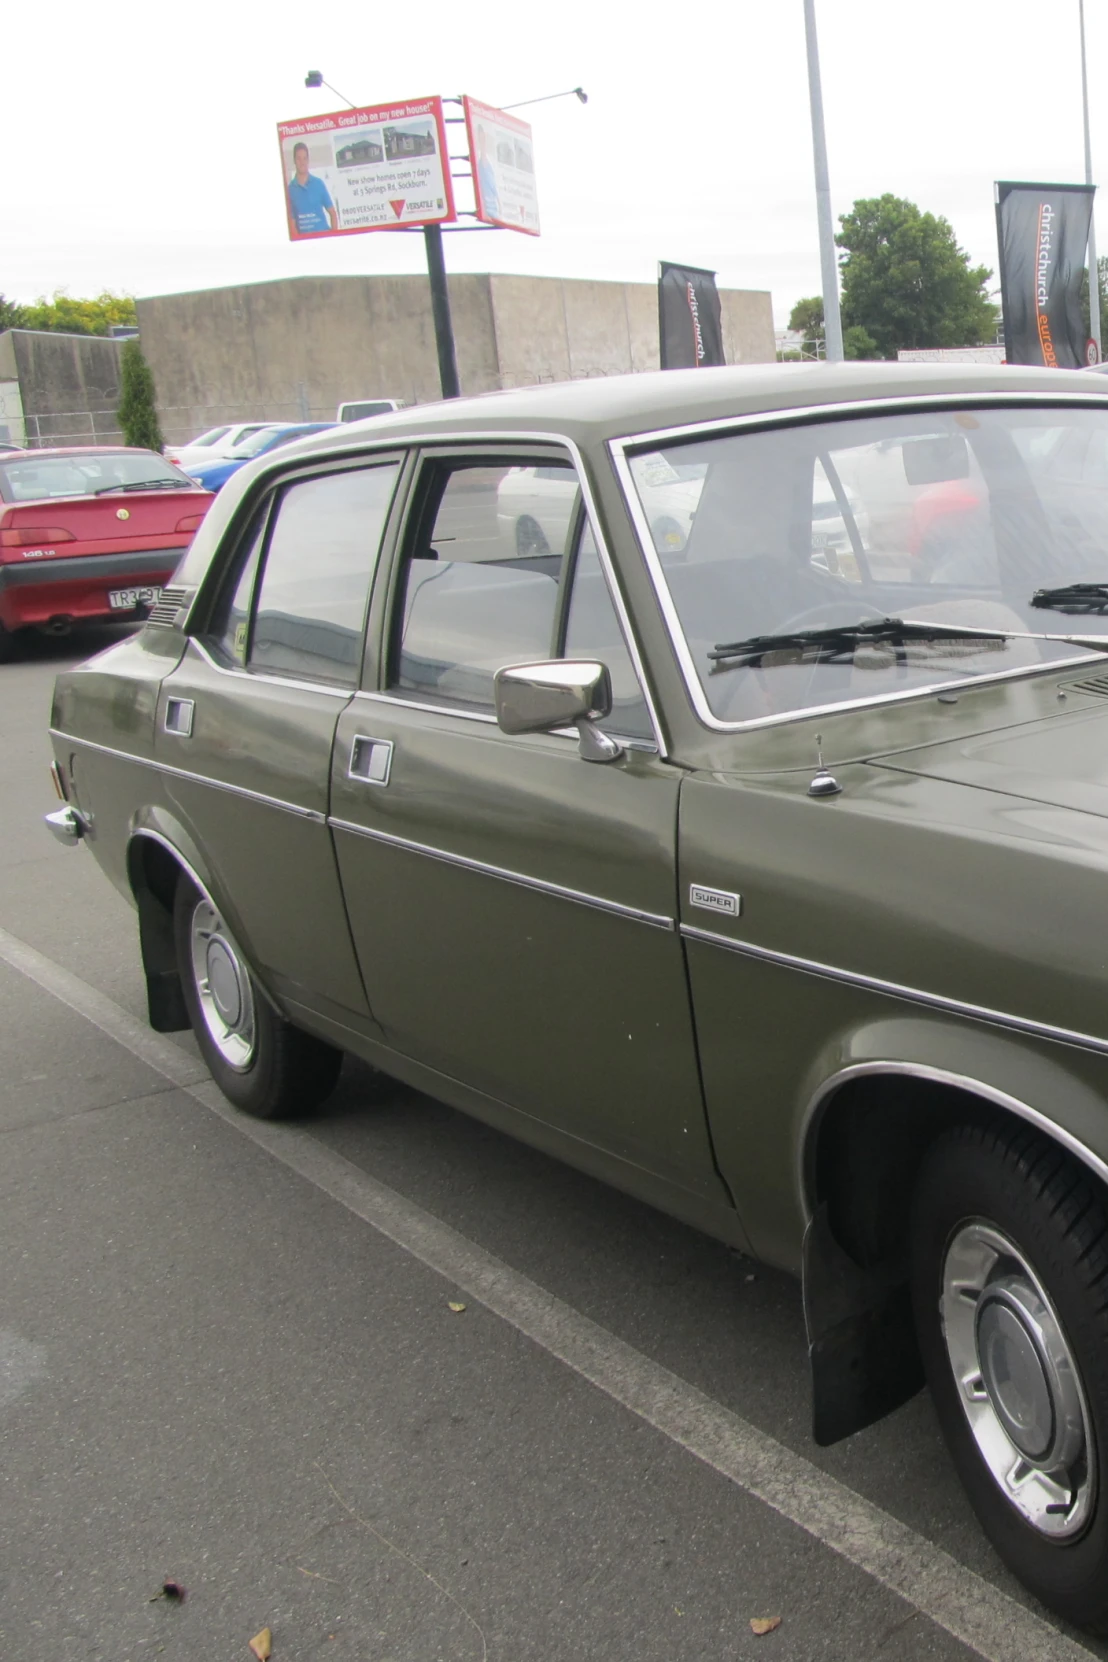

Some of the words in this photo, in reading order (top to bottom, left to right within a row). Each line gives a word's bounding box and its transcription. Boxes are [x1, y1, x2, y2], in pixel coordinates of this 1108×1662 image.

[338, 116, 357, 126] Great
[357, 112, 368, 125] job
[369, 113, 378, 121] on
[379, 110, 390, 121] my
[391, 108, 405, 118] new
[347, 177, 360, 186] New
[360, 174, 375, 185] show
[376, 172, 397, 182] homes
[397, 171, 412, 181] open
[417, 168, 431, 178] days
[365, 184, 387, 195] Springs
[406, 200, 434, 210] VERSATILE
[1037, 204, 1055, 306] christchurch
[688, 281, 706, 360] christchurch
[695, 892, 731, 907] SUPER
